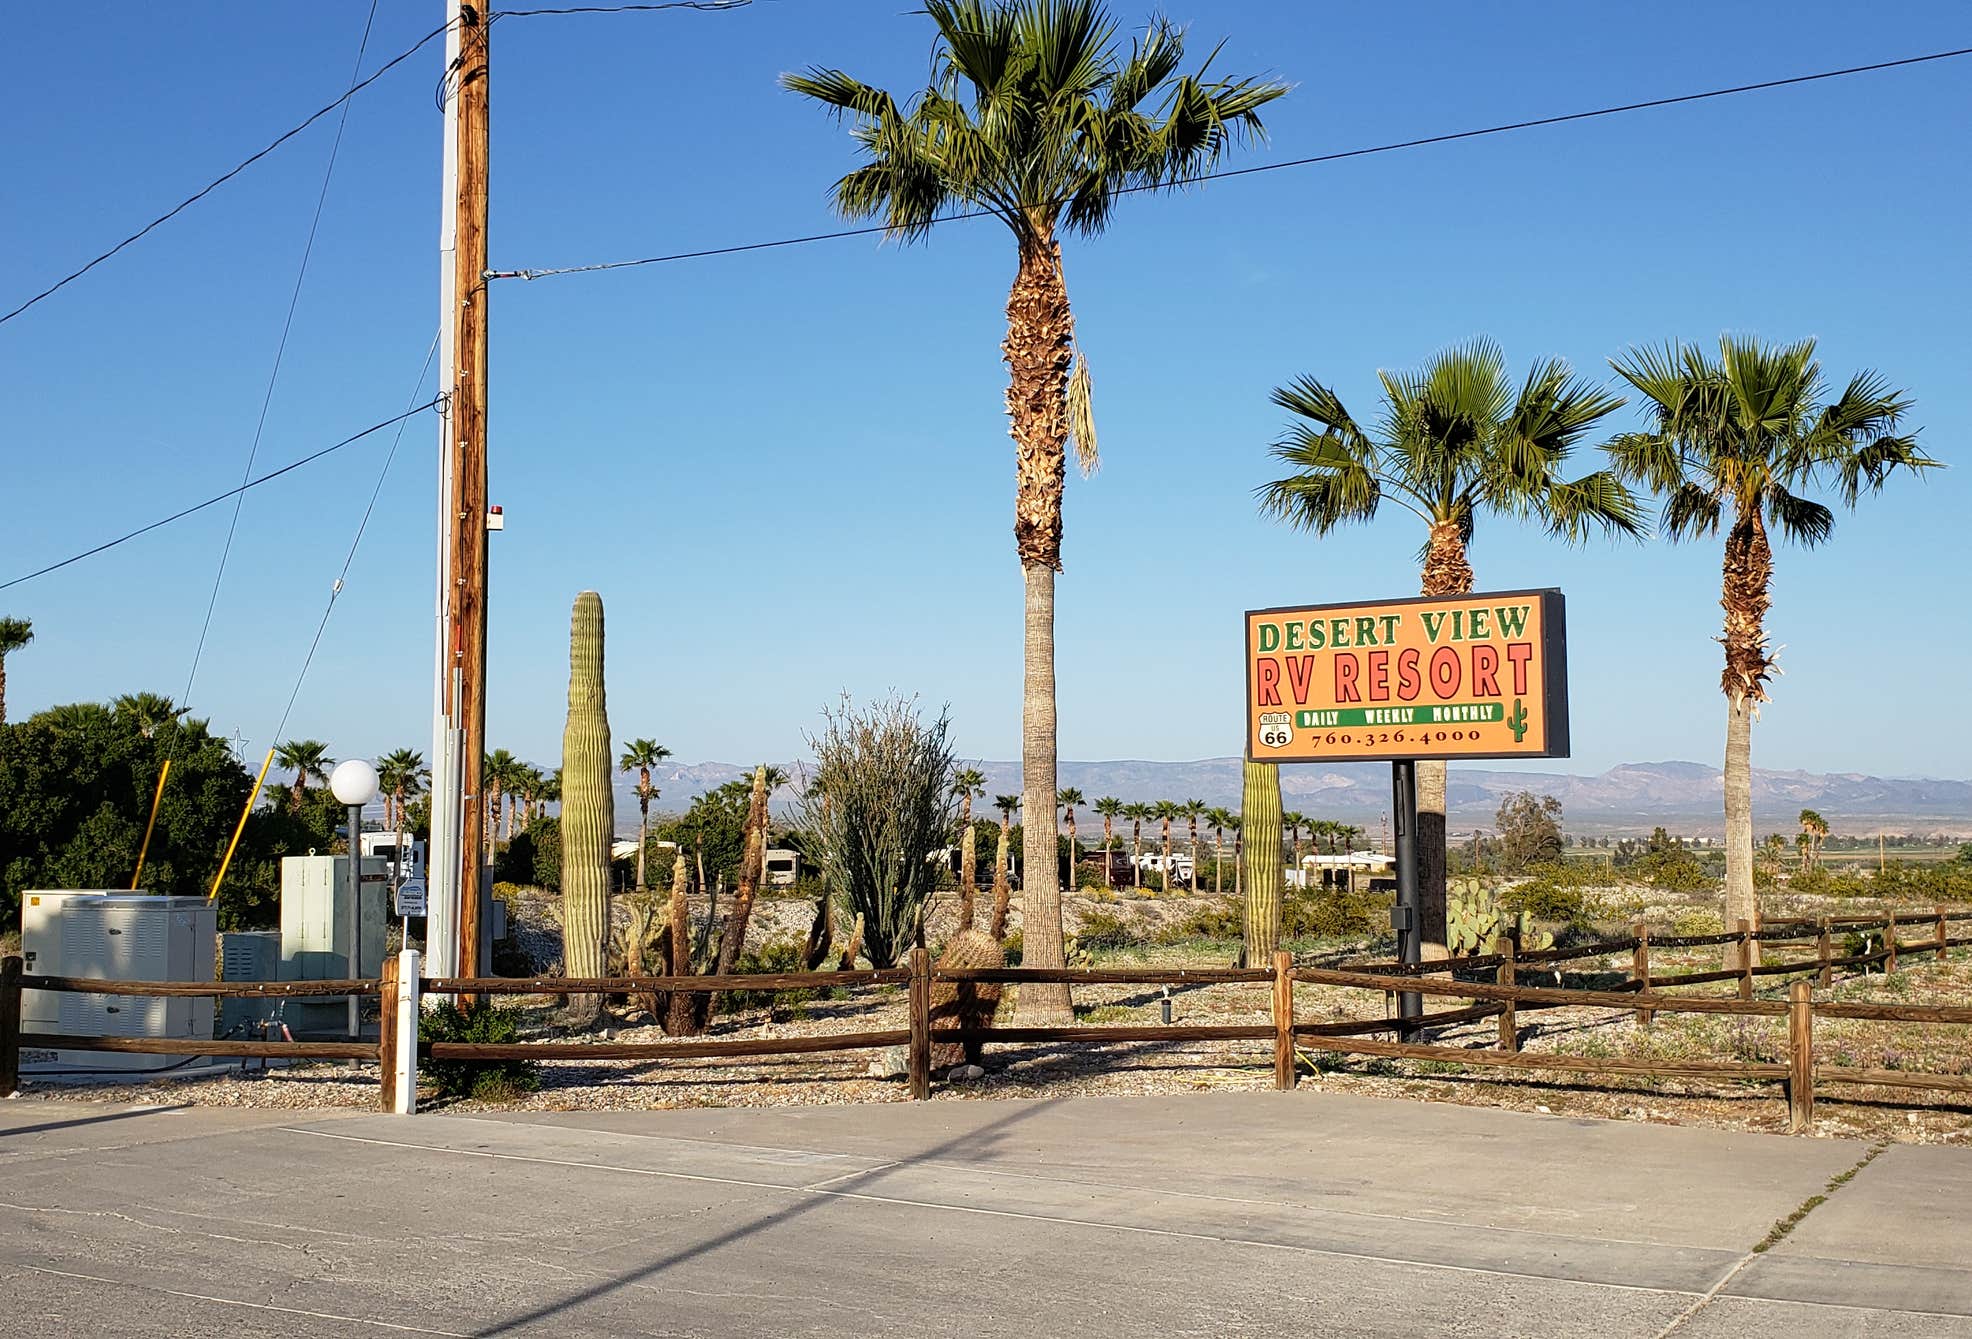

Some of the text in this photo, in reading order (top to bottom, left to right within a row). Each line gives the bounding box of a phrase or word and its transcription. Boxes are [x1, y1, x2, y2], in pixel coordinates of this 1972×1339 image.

[1258, 606, 1531, 652] DESERT VIEW
[1257, 643, 1532, 706] RV RESORT
[1263, 714, 1288, 722] ROUTE
[1303, 705, 1494, 726] DAILY WEEKLY MONTHLY
[1265, 731, 1287, 744] 66
[1312, 729, 1481, 749] 760.326.4000
